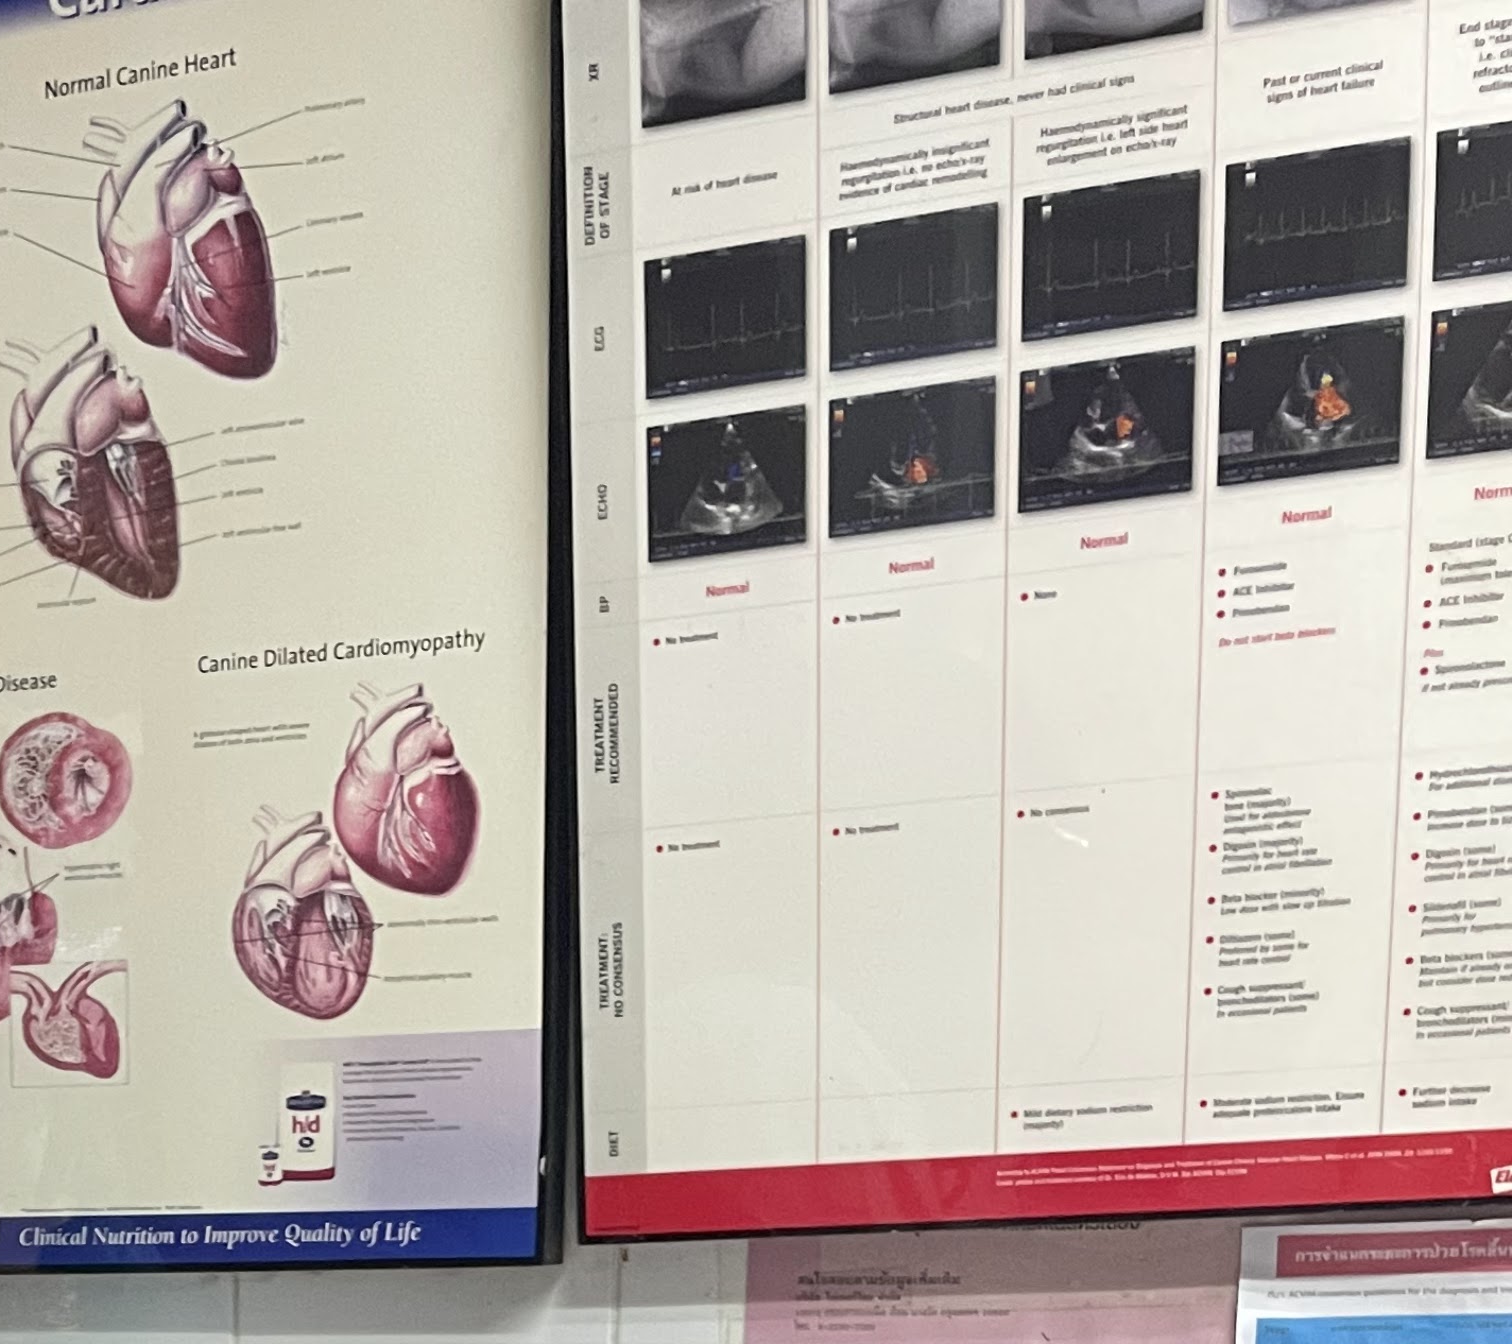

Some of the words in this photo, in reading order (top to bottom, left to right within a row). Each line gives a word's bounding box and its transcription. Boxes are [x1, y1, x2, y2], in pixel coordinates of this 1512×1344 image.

[45, 69, 112, 99] Normal
[116, 60, 180, 86] Canine
[184, 47, 238, 75] Heart
[588, 63, 600, 82] XR
[1303, 66, 1342, 82] current
[1345, 59, 1384, 75] clinical
[1047, 85, 1067, 97] had
[1069, 78, 1107, 94] clinical
[1297, 86, 1308, 98] of
[1310, 83, 1339, 96] heart
[1341, 78, 1376, 91] failure
[599, 172, 611, 215] STAGE
[584, 166, 595, 246] DEFINITION
[599, 222, 611, 240] OF
[594, 326, 606, 351] ECG
[597, 484, 609, 520] ECHO
[1473, 485, 1512, 501] Norm
[1280, 505, 1333, 525] Normal
[1080, 531, 1129, 550] Normal
[888, 556, 936, 575] Normal
[705, 580, 751, 598] Normal
[599, 595, 610, 613] BP
[197, 651, 259, 676] Canine
[263, 642, 328, 668] Dilated
[332, 628, 487, 663] Cardiomyopathy
[594, 697, 605, 774] TREATMENT
[608, 683, 620, 784] RECOMMENDED
[612, 922, 624, 997] CONSENSUS
[613, 998, 624, 1018] NO
[608, 1131, 619, 1157] DIET
[19, 1225, 88, 1247] Clinical
[91, 1225, 175, 1246] Nutrition
[180, 1228, 199, 1244] to
[204, 1225, 279, 1250] Improve
[285, 1222, 354, 1248] Quality
[359, 1220, 383, 1248] of
[384, 1220, 422, 1247] Life
